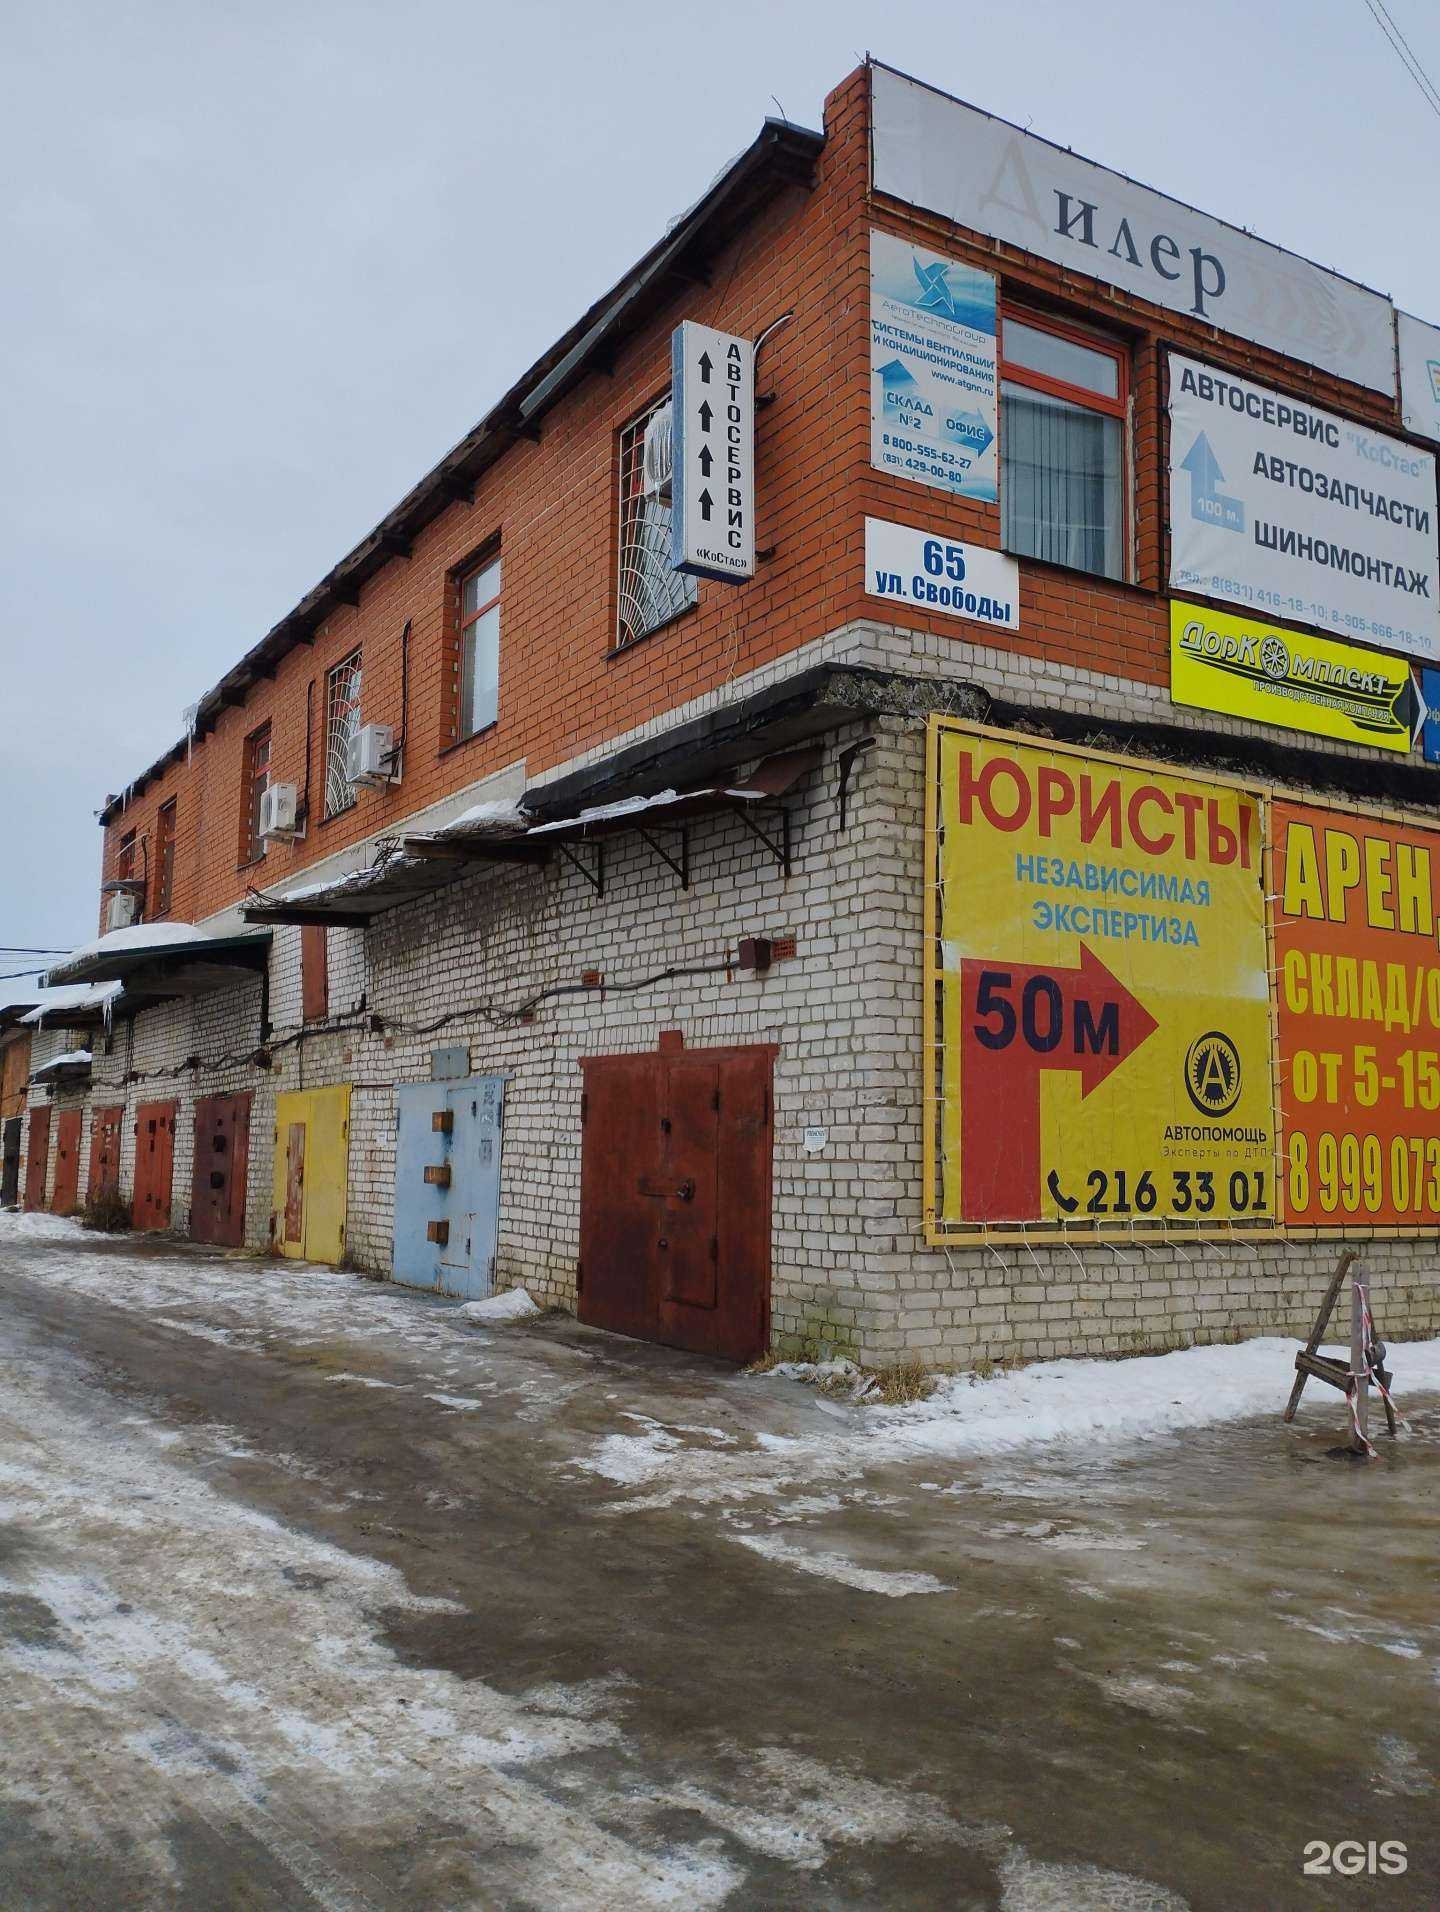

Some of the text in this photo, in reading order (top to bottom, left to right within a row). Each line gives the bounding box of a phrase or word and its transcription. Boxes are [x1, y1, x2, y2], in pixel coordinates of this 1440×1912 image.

[873, 320, 925, 345] СИСТЕМЫ
[927, 338, 995, 370] ВЕНТИЛЯЦИИ
[873, 334, 995, 383] И КОНДИЦИОНИРОВАНИЯ
[886, 392, 934, 417] СКЛАД
[931, 370, 994, 397] www.atgnn.ru
[946, 419, 985, 441] ОФИС
[1180, 368, 1340, 449] АВТОСЕРВИС
[726, 343, 742, 549] АВТОСЕРВИС
[883, 434, 972, 470] 8 800-555-62-27
[883, 452, 962, 483] (831) 429-00-80
[1252, 451, 1430, 534] АВТОЗАПЧАСТИ
[923, 540, 966, 582] 65
[1254, 519, 1430, 598] ШИНОМОНТАЖ
[875, 570, 1011, 622] ул. Свободы
[1253, 680, 1390, 721] ПРОИЗВОДСТВЕННАЯ КОМПАНИЯ
[959, 751, 1251, 870] ЮРИСТЫ
[1016, 853, 1211, 906] НЕЗАВИСИМАЯ
[1282, 821, 1440, 951] АРЕН
[1032, 900, 1200, 946] ЭКСПЕРТИЗА
[1163, 1145, 1267, 1160] Эксперты по ДТП
[1164, 1125, 1267, 1144] АВТОПОМОЩЬ
[1086, 1170, 1267, 1213] 216 33 01
[1288, 1131, 1309, 1214] 8
[1318, 1132, 1383, 1213] 999
